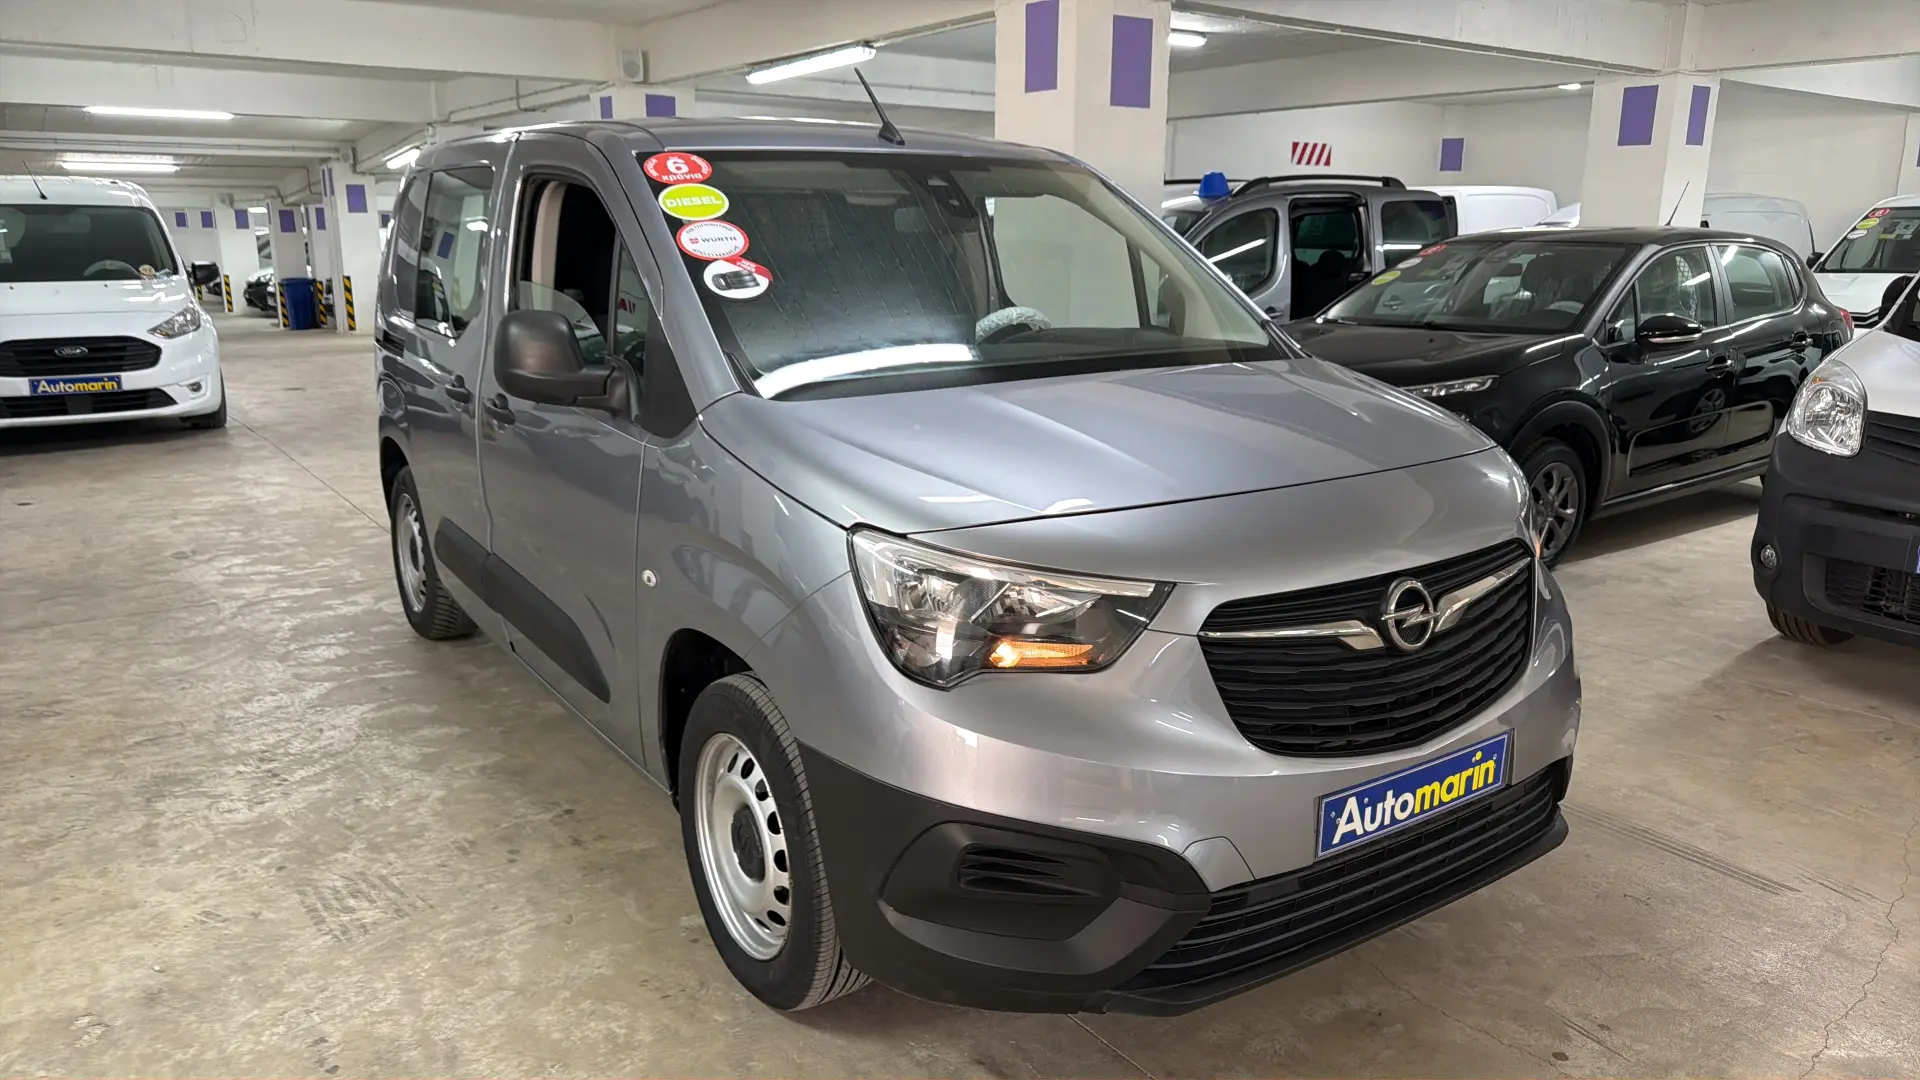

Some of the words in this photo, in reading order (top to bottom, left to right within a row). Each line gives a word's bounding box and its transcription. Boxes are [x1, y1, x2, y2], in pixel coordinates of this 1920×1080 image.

[666, 158, 689, 174] 6
[665, 196, 723, 207] DIESEL
[37, 377, 118, 393] Automarin
[1331, 750, 1496, 845] Automarin
